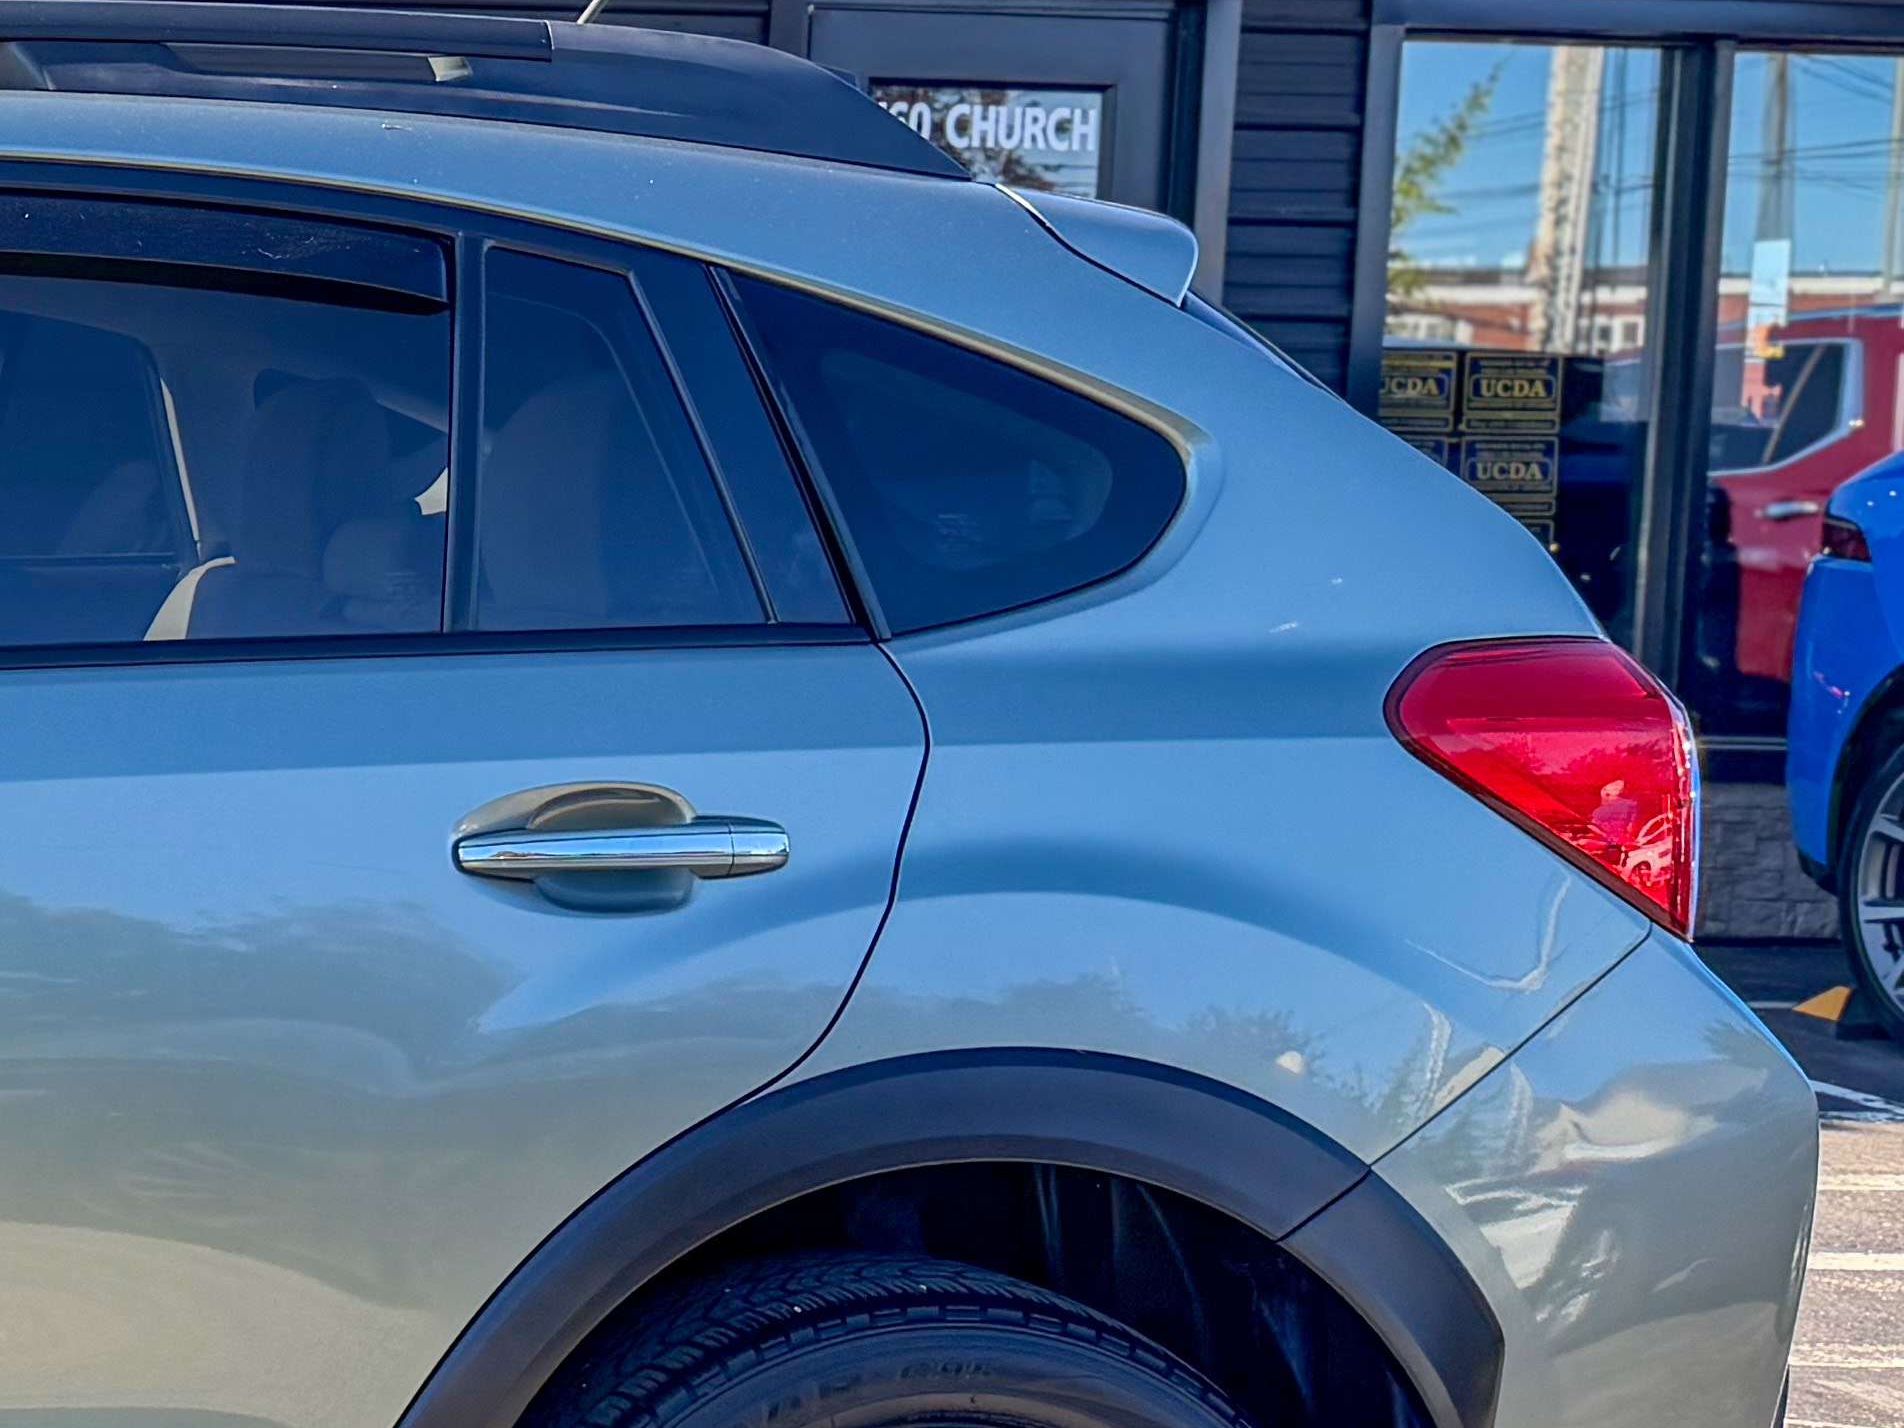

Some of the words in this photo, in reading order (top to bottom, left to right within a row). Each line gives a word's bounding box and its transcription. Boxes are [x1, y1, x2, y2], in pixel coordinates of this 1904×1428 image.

[945, 102, 1097, 152] CHURCH
[1480, 379, 1547, 397] UCDA
[1476, 462, 1543, 480] UCDA
